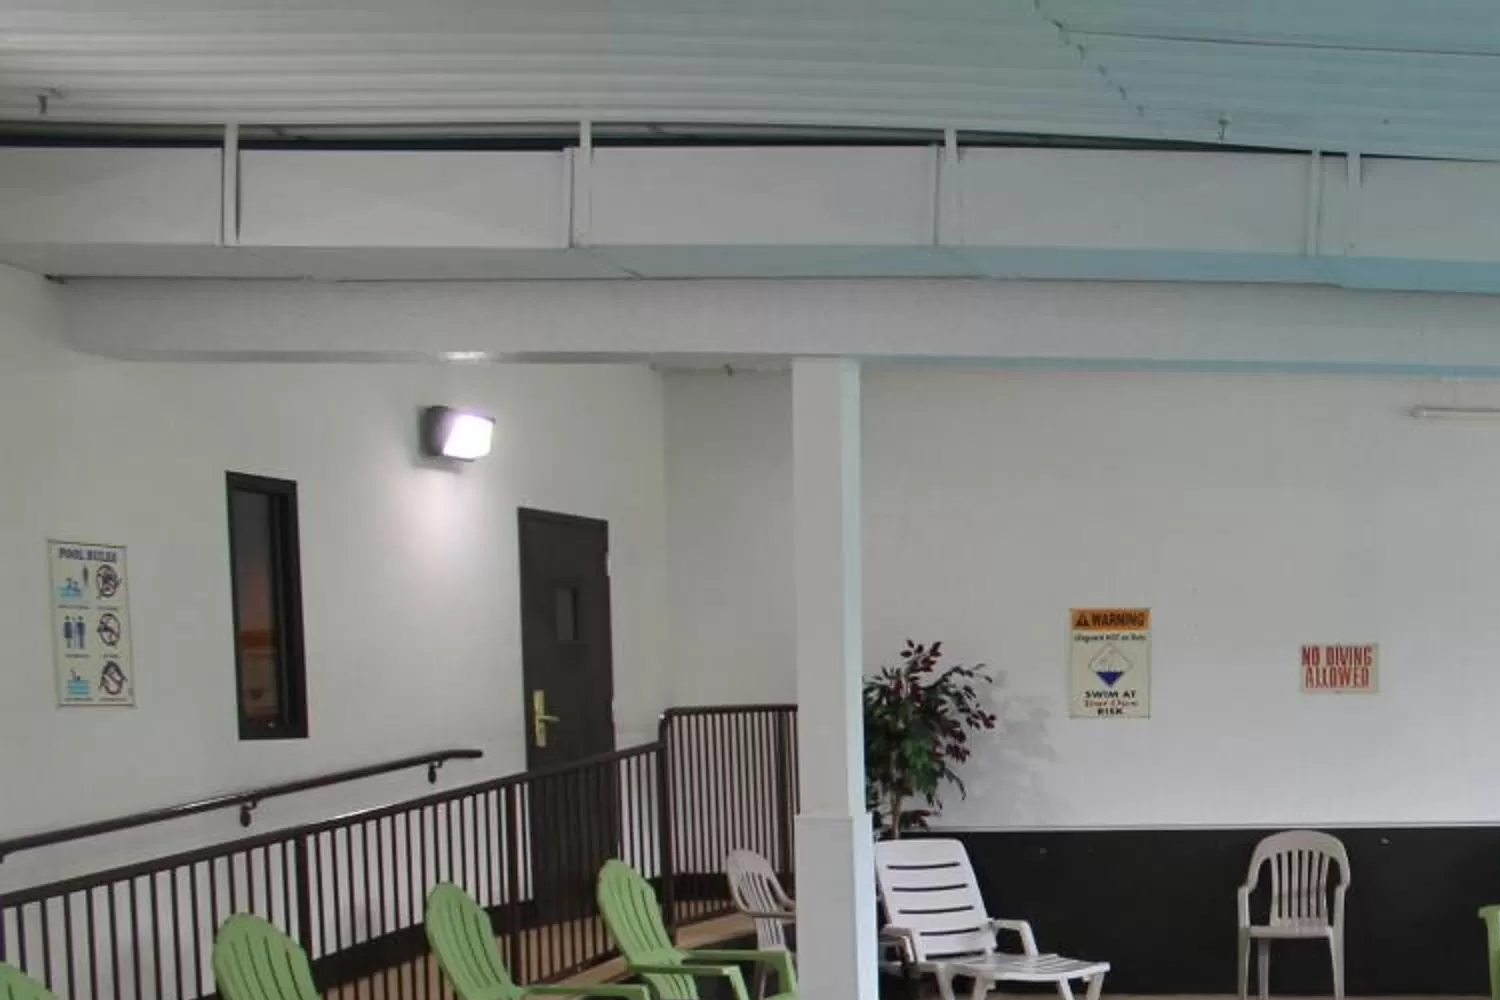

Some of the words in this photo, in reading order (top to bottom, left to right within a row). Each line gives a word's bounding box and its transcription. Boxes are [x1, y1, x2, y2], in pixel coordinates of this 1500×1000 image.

[1092, 612, 1145, 627] WARNING
[1301, 645, 1320, 666] NO
[1326, 645, 1372, 666] DIVING
[1305, 666, 1369, 689] ALLOWED
[1084, 690, 1119, 699] SWIM
[1123, 690, 1136, 699] AT
[1097, 707, 1124, 716] RISK
